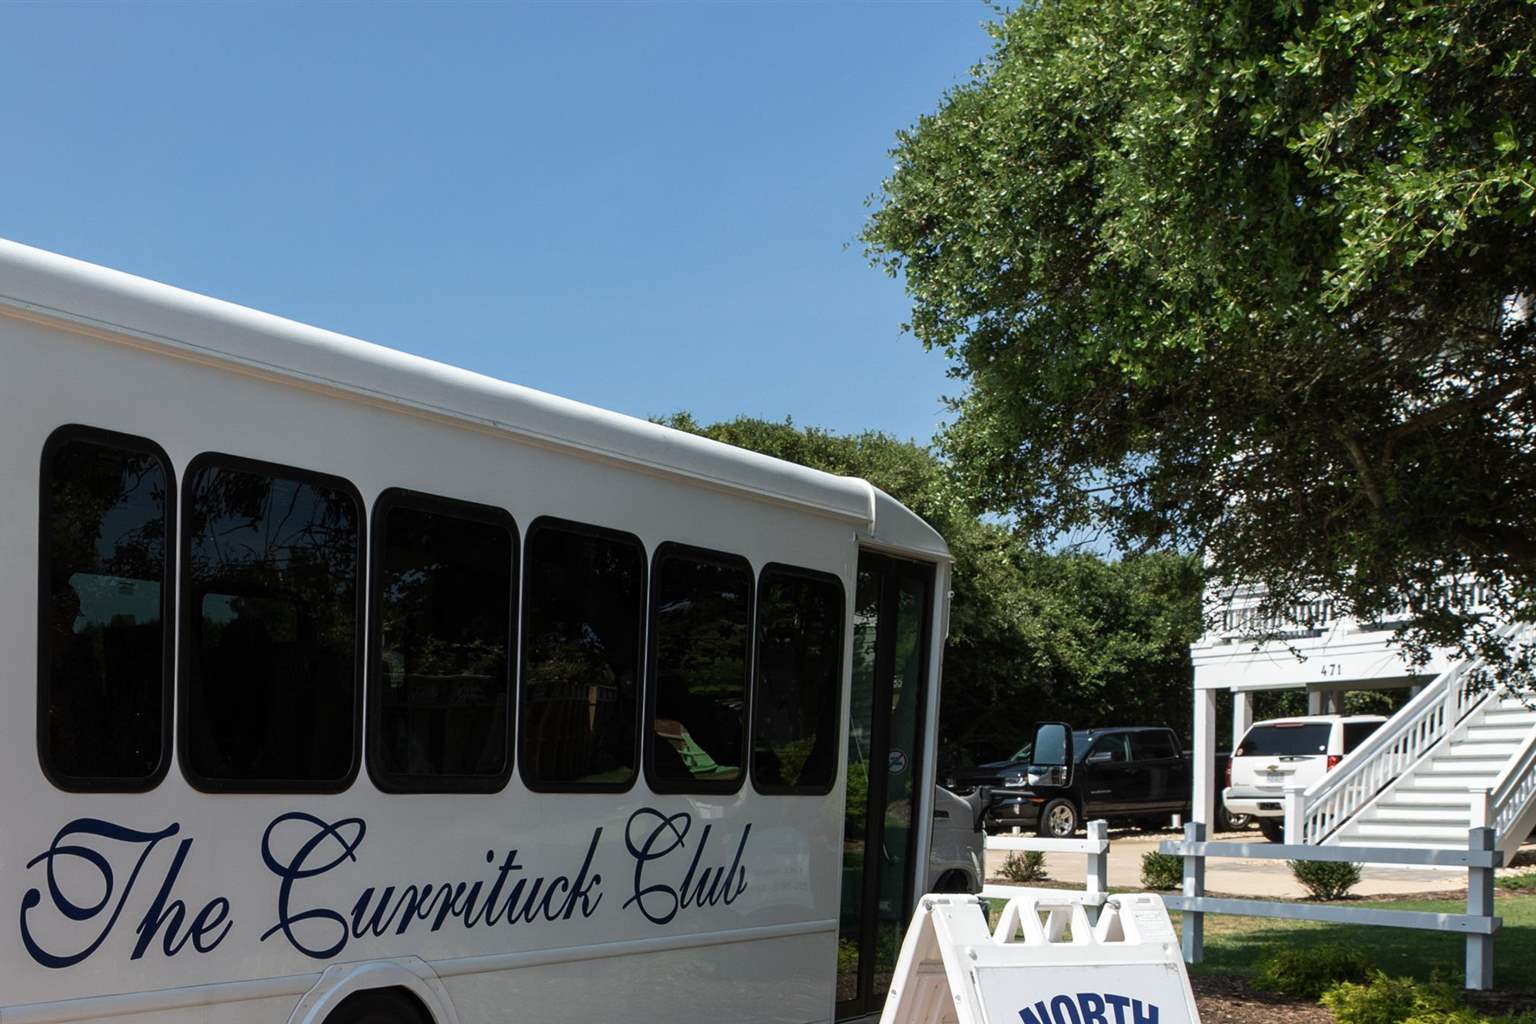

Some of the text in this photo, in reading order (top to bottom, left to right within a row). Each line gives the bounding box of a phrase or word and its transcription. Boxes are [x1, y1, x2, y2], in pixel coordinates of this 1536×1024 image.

[1320, 664, 1341, 676] 471
[19, 807, 752, 969] The Currituck Club
